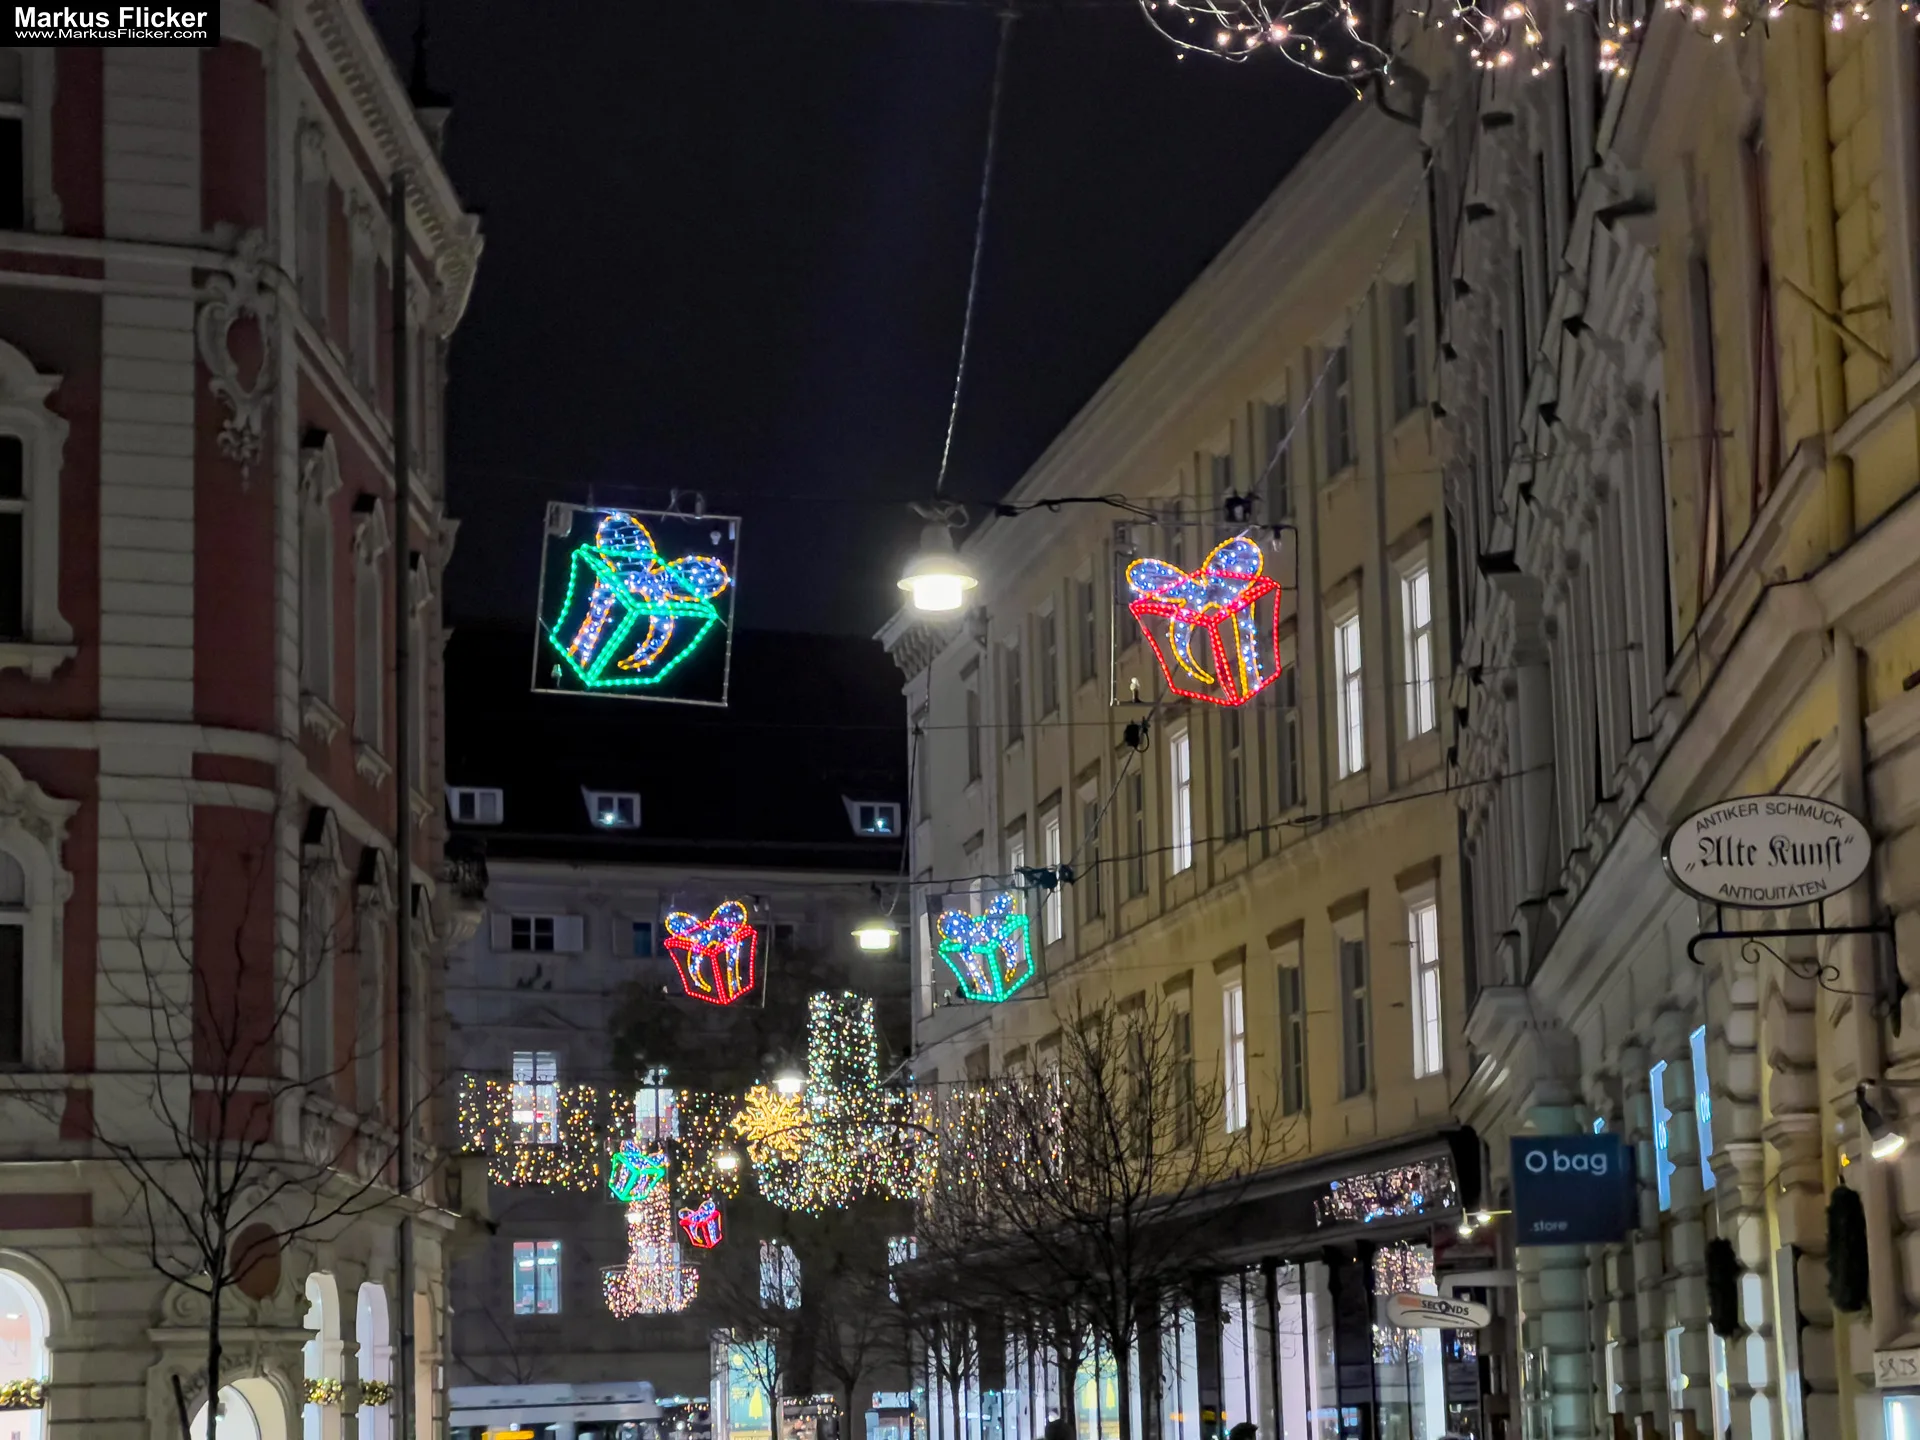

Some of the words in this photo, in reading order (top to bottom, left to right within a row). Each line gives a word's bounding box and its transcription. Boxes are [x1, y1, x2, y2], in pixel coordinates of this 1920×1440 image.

[1696, 802, 1760, 834] ANTIKER
[1765, 801, 1846, 829] SCHMUCK
[1718, 878, 1828, 901] ANTIQUITÄTEN
[1525, 1149, 1548, 1173] O
[1552, 1149, 1608, 1177] bag
